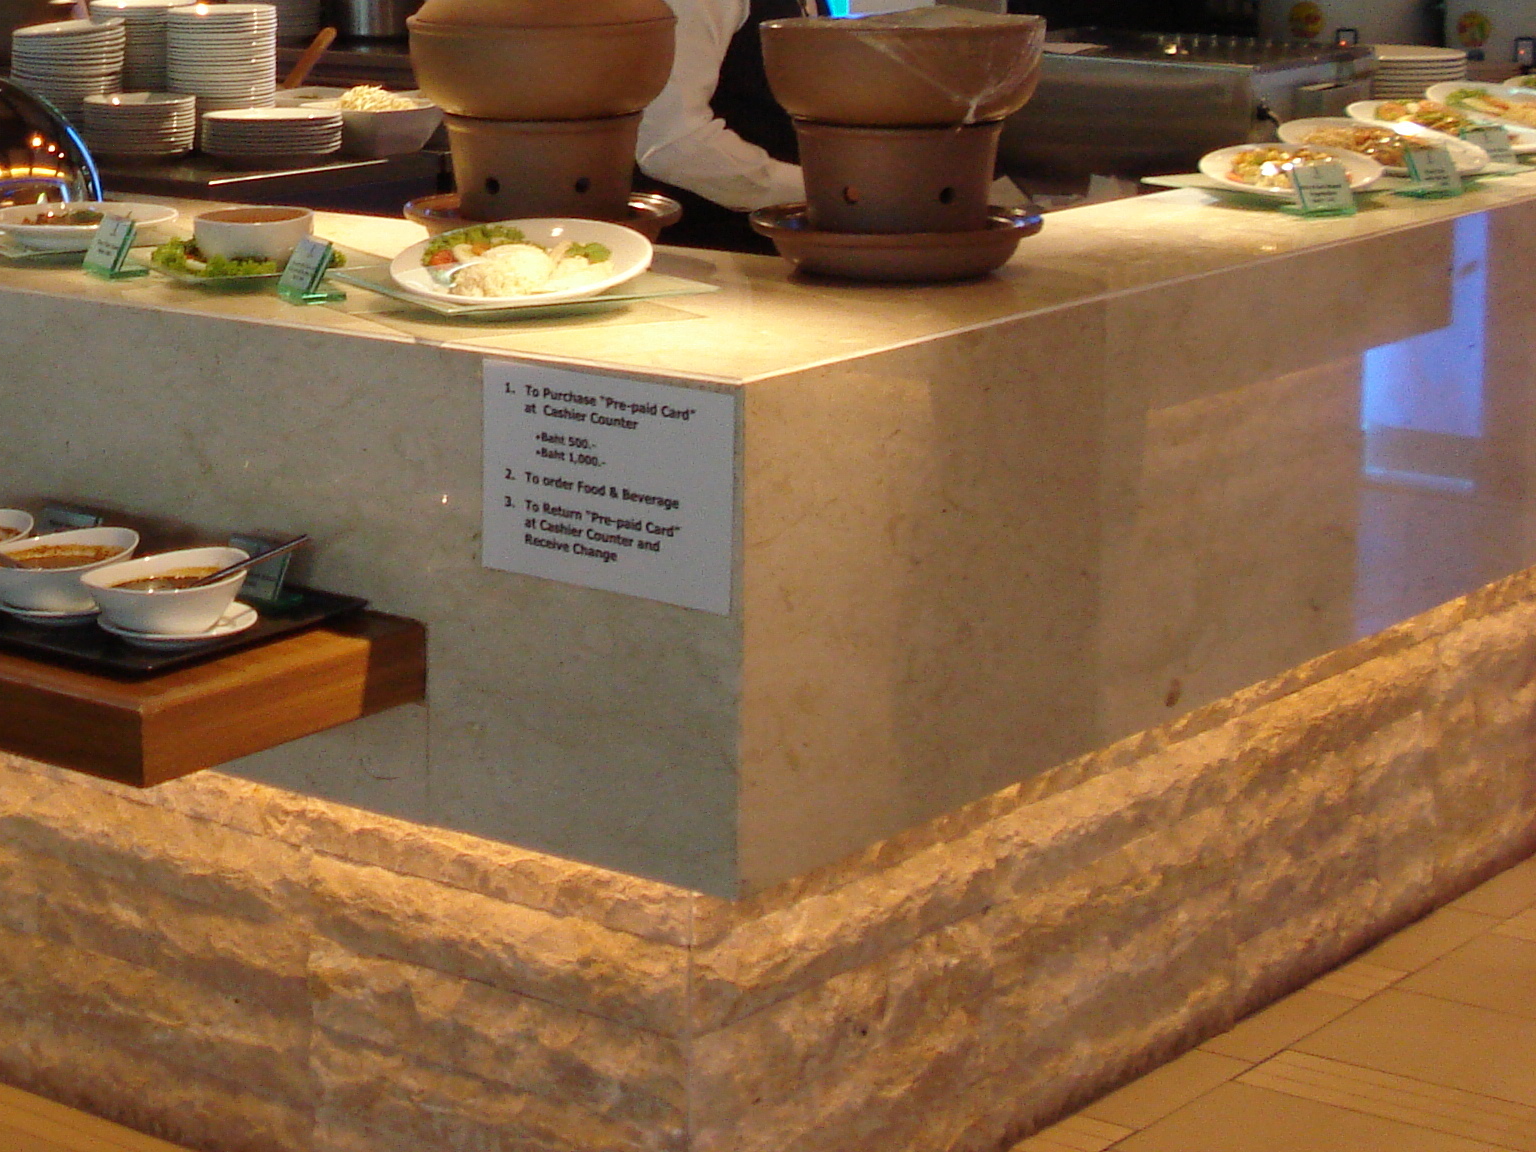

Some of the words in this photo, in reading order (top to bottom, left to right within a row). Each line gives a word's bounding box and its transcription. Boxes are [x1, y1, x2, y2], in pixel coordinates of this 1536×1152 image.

[525, 385, 539, 398] To
[543, 388, 596, 406] Purchase
[524, 404, 536, 414] at
[544, 406, 586, 421] Cashier
[590, 412, 639, 429] Counter
[525, 472, 539, 484] To
[543, 475, 573, 490] order
[578, 482, 605, 497] Food
[609, 487, 618, 498] &
[623, 488, 679, 510] Beverage
[525, 499, 539, 513] To
[543, 503, 582, 521] Return
[524, 519, 537, 529] at
[540, 520, 582, 538] Cashier
[586, 529, 634, 548] Counter
[637, 539, 660, 552] and
[525, 534, 569, 553] Receive
[573, 543, 617, 562] Change
